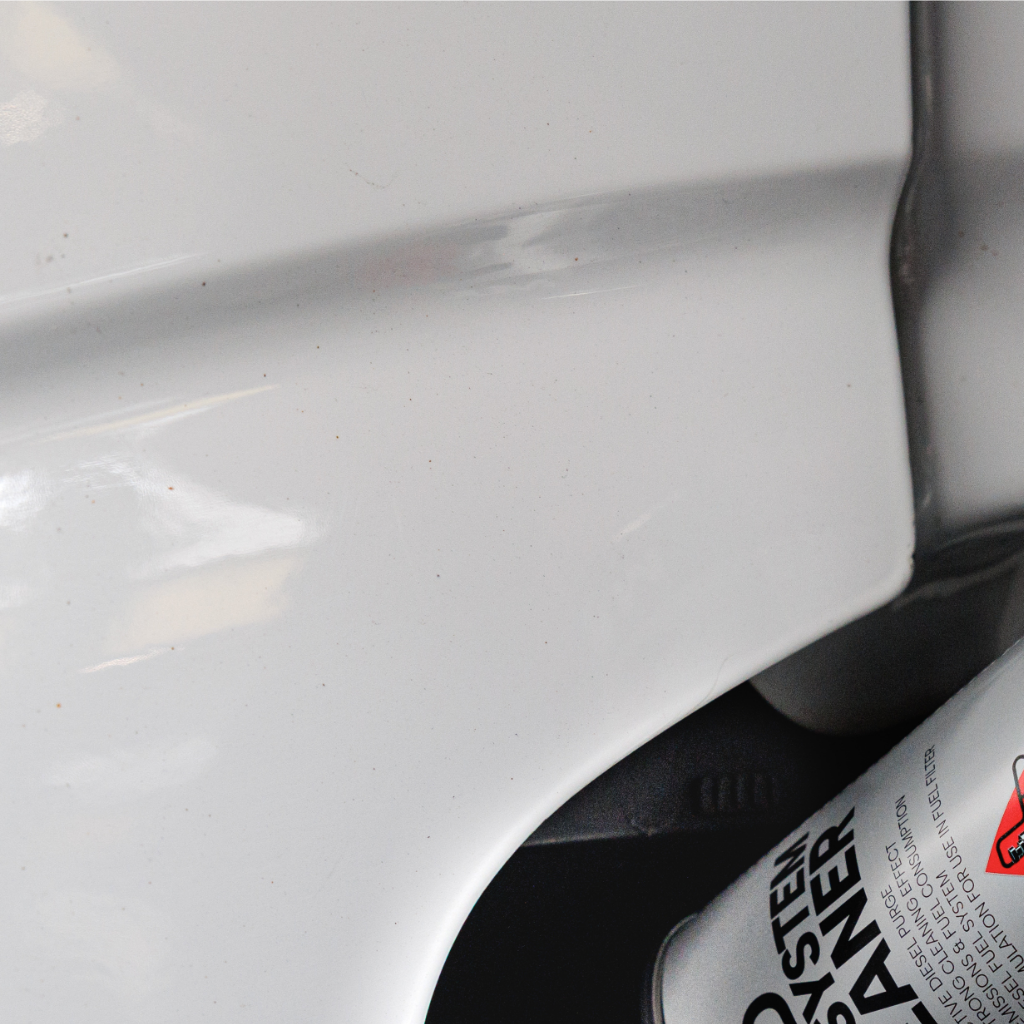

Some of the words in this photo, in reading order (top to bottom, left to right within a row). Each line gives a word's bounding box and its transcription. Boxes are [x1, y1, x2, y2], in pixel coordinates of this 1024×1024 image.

[923, 743, 936, 787] FILTER
[927, 782, 944, 821] FUEL
[893, 793, 933, 896] CONSUMPTION
[935, 818, 950, 838] IN
[884, 840, 913, 897] EFFECT
[941, 835, 963, 870] USE
[935, 867, 974, 933] SYSTEM
[956, 866, 980, 903] FOR
[879, 883, 911, 938] PURGE
[929, 896, 957, 940] FUEL
[905, 895, 955, 976] CLEANING
[949, 936, 966, 954] &
[972, 929, 1003, 973] FUEL
[906, 936, 943, 992] DIESEL
